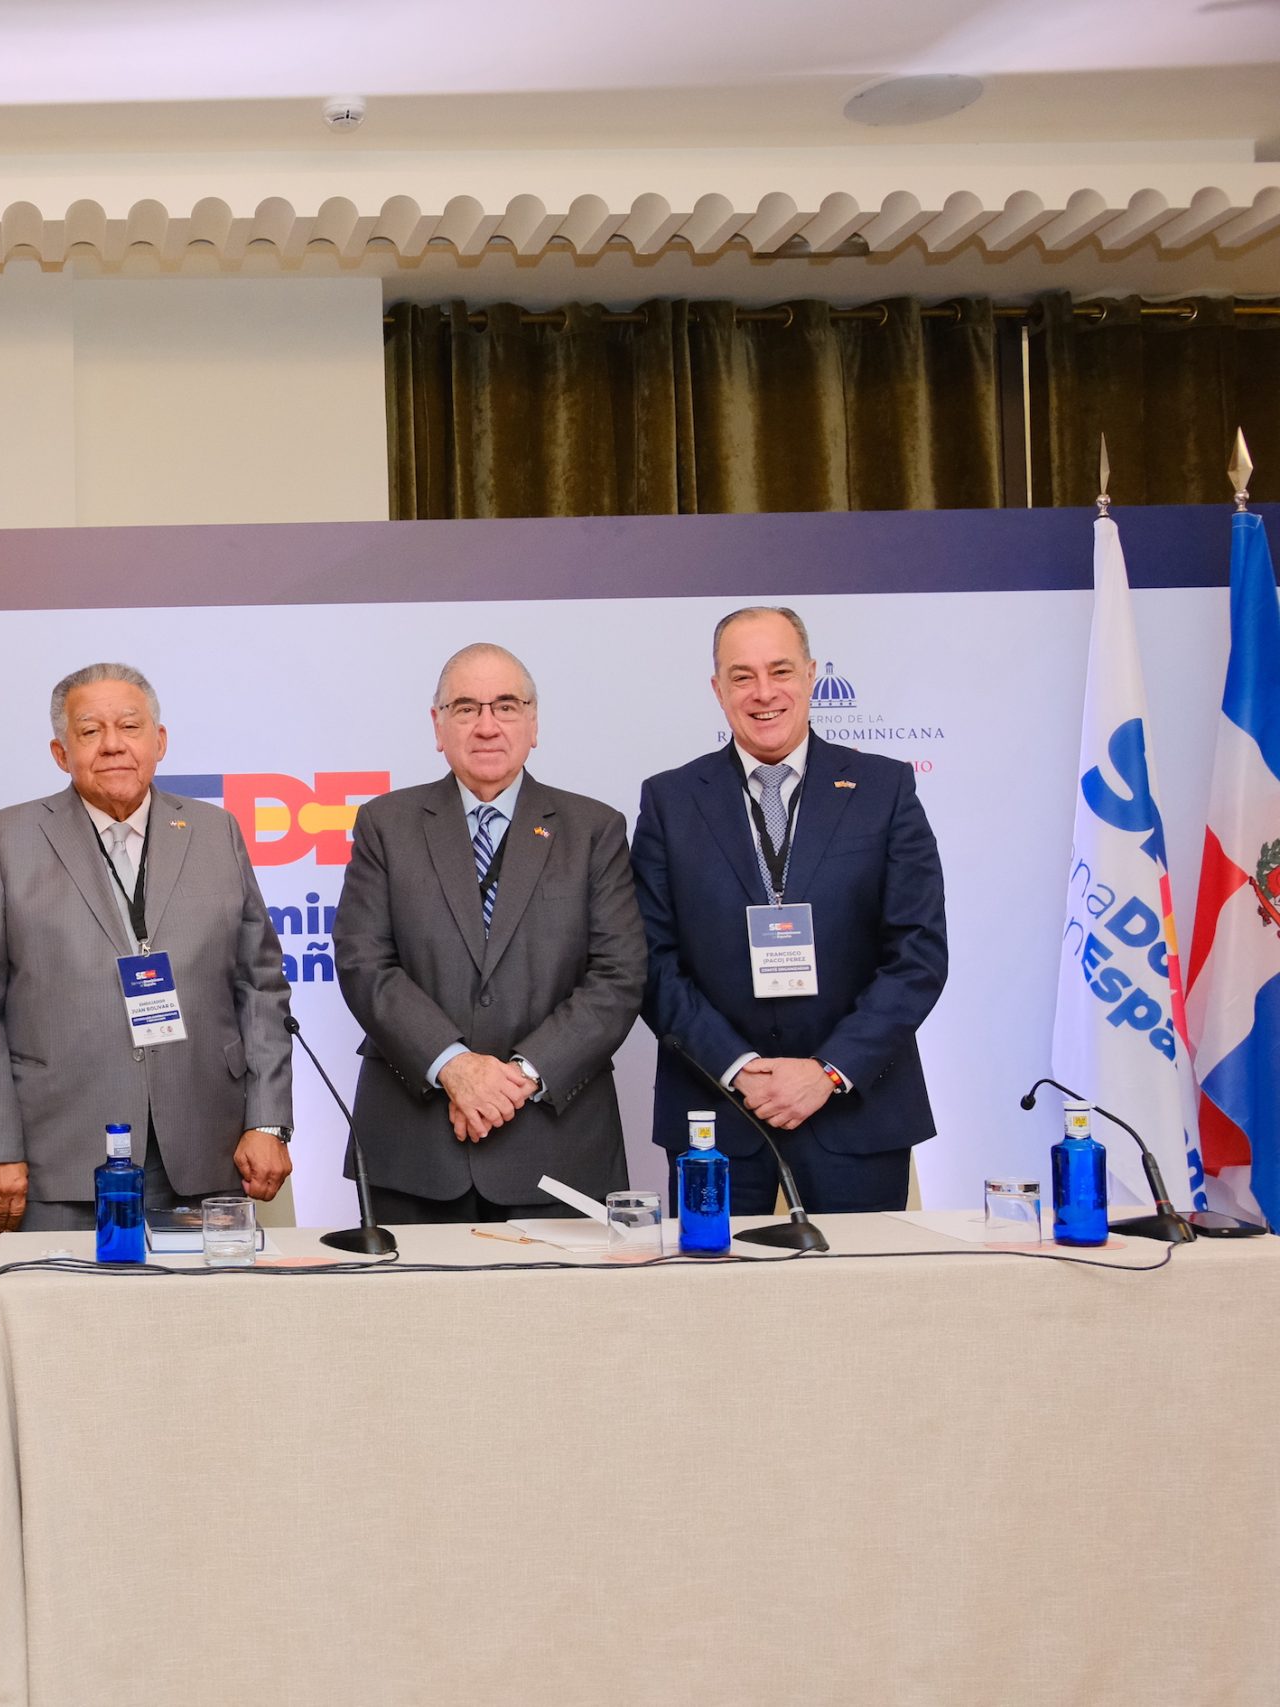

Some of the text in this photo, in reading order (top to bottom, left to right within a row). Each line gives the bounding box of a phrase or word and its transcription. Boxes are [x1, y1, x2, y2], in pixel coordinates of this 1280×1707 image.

[848, 715, 863, 723] DE
[869, 714, 884, 722] LA
[825, 728, 945, 740] DOMINICANA
